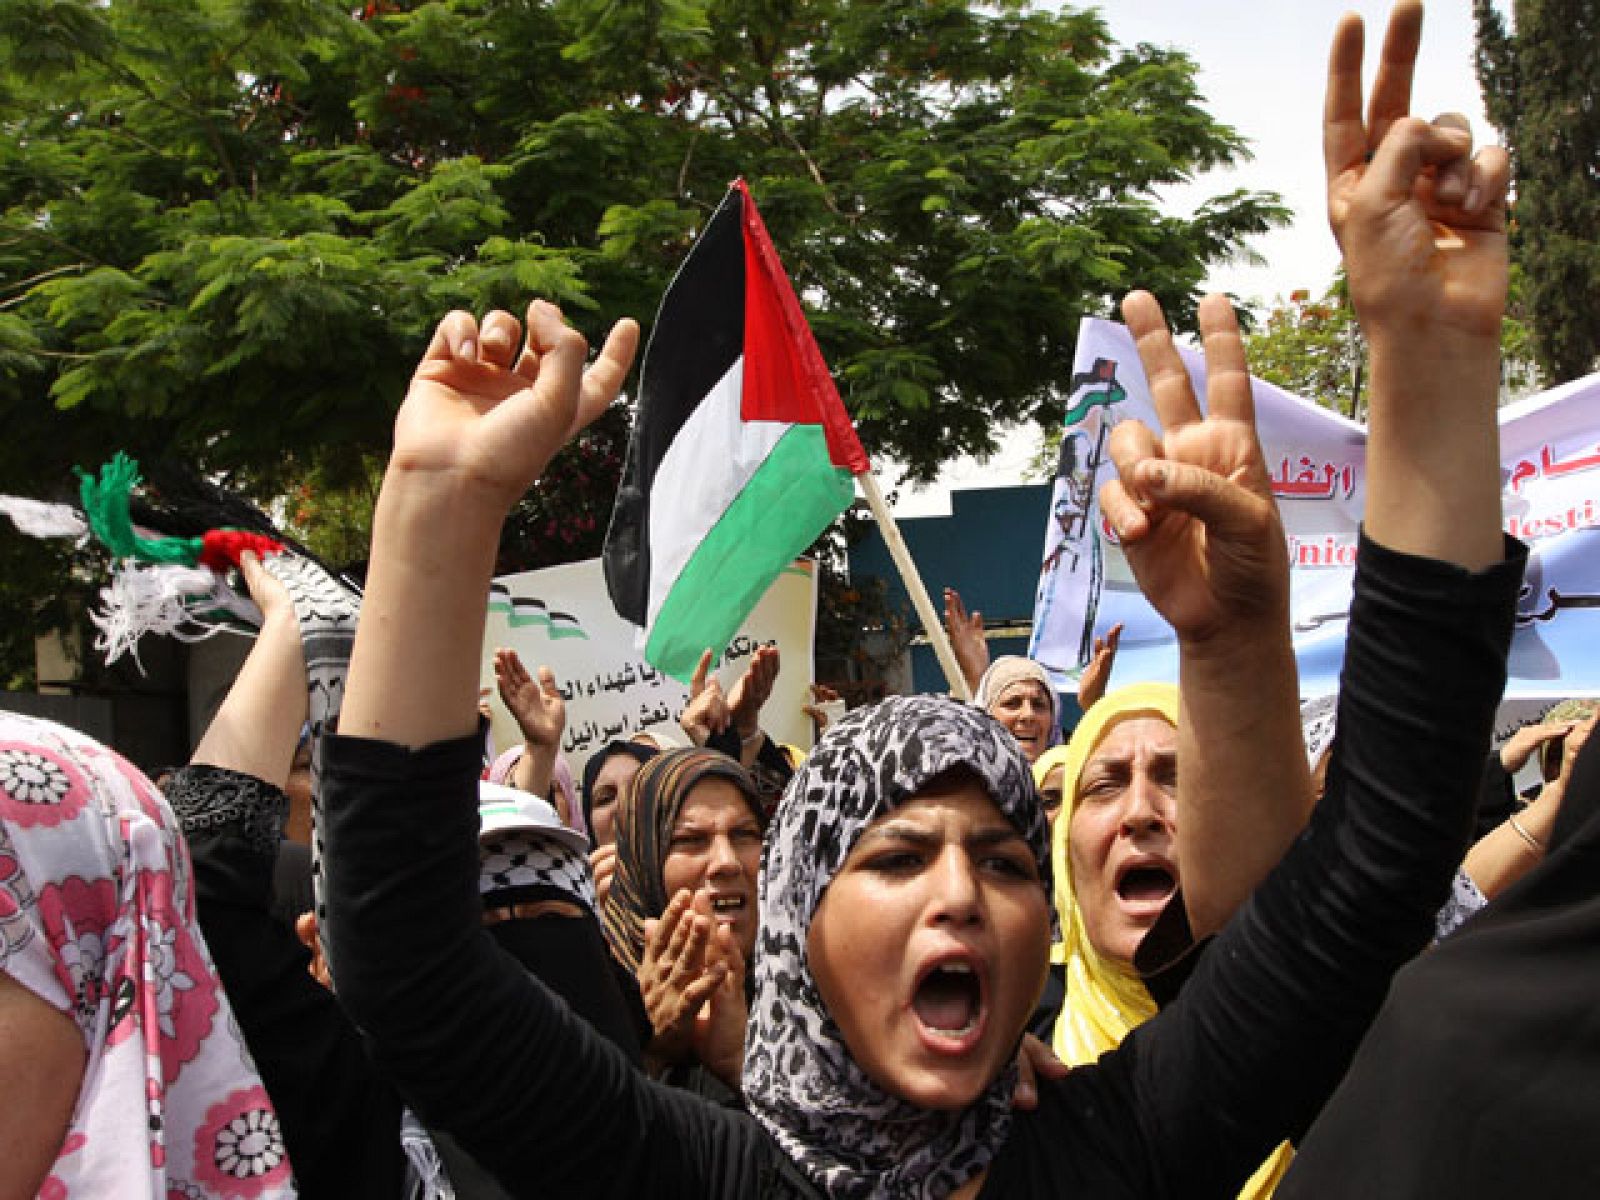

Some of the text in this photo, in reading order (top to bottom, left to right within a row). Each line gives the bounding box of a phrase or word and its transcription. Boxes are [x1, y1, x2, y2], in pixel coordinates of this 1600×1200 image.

[1266, 456, 1355, 500] الفل
[1289, 500, 1594, 566] nio lesti
